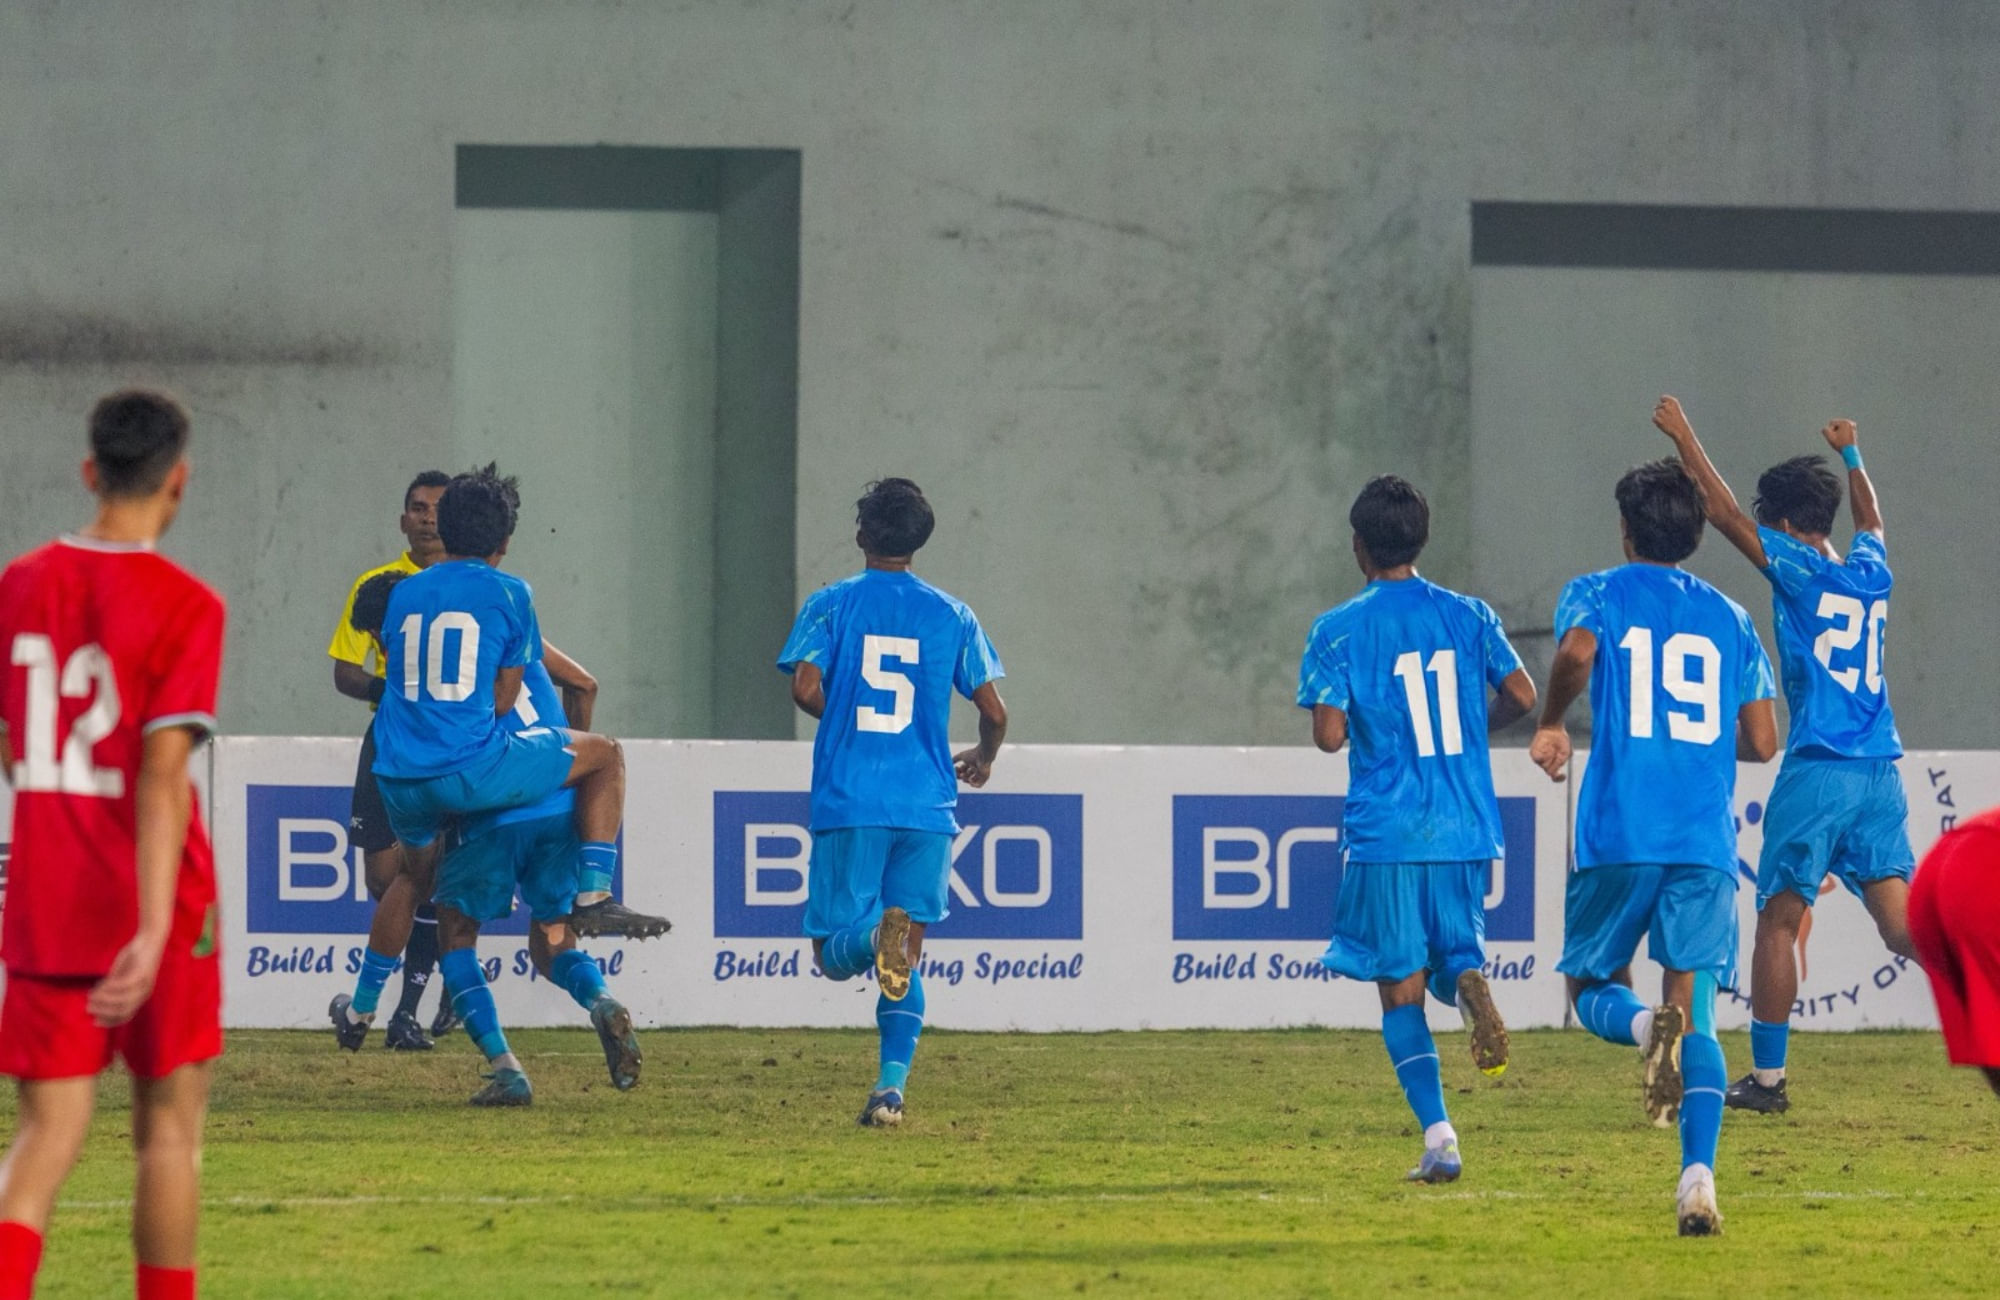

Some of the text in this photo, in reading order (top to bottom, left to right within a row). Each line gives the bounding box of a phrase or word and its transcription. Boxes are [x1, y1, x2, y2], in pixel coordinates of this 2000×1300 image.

[399, 611, 480, 702] 10
[856, 634, 920, 734] 5
[1619, 626, 1722, 746] 19
[1814, 591, 1888, 694] 20
[10, 632, 125, 799] 12
[1393, 649, 1464, 758] 11
[246, 946, 335, 977] Build
[713, 949, 800, 982] Build
[974, 952, 1084, 985] Special
[1172, 951, 1257, 984] Build
